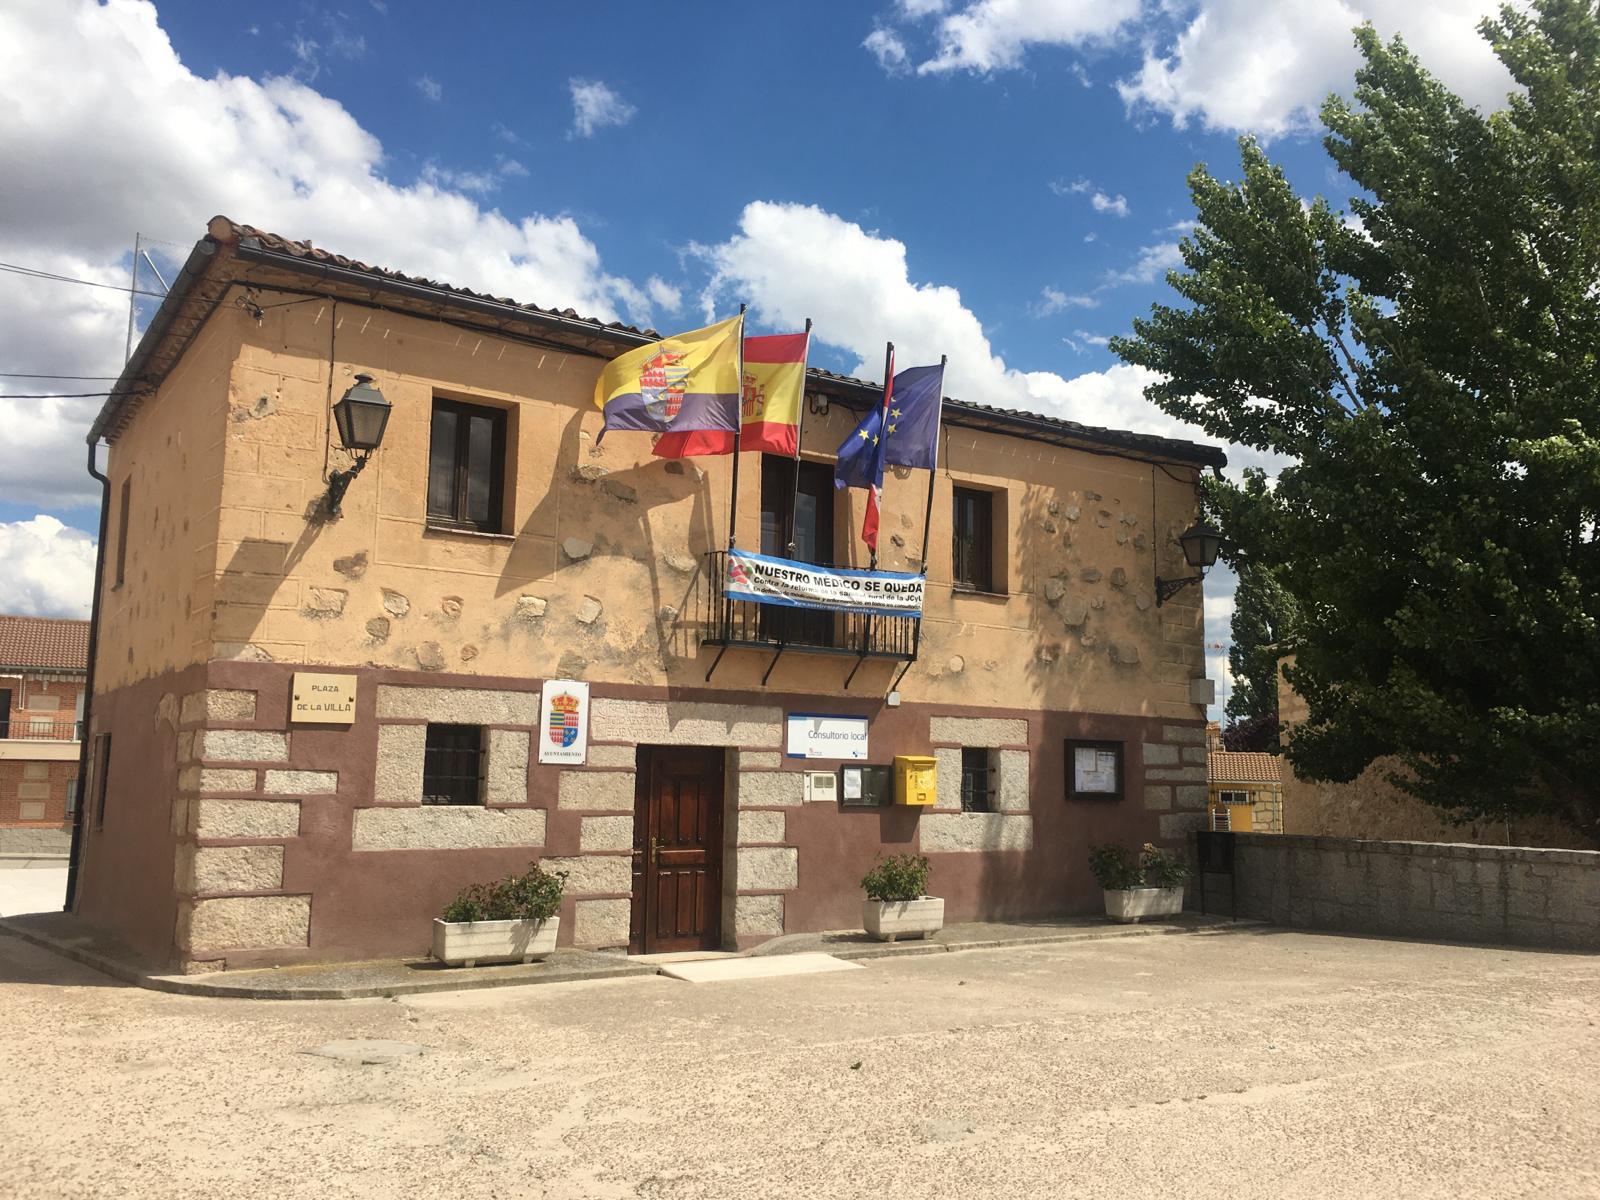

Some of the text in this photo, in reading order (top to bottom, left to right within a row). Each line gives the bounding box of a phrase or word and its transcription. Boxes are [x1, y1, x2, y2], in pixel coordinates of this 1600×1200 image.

[755, 564, 810, 584] NUESTRO
[864, 581, 880, 592] SE
[884, 582, 922, 593] QUEDA
[754, 577, 779, 587] Contra
[906, 594, 921, 602] JCyL
[324, 703, 351, 712] VILLA
[808, 730, 867, 741] Consultorio local
